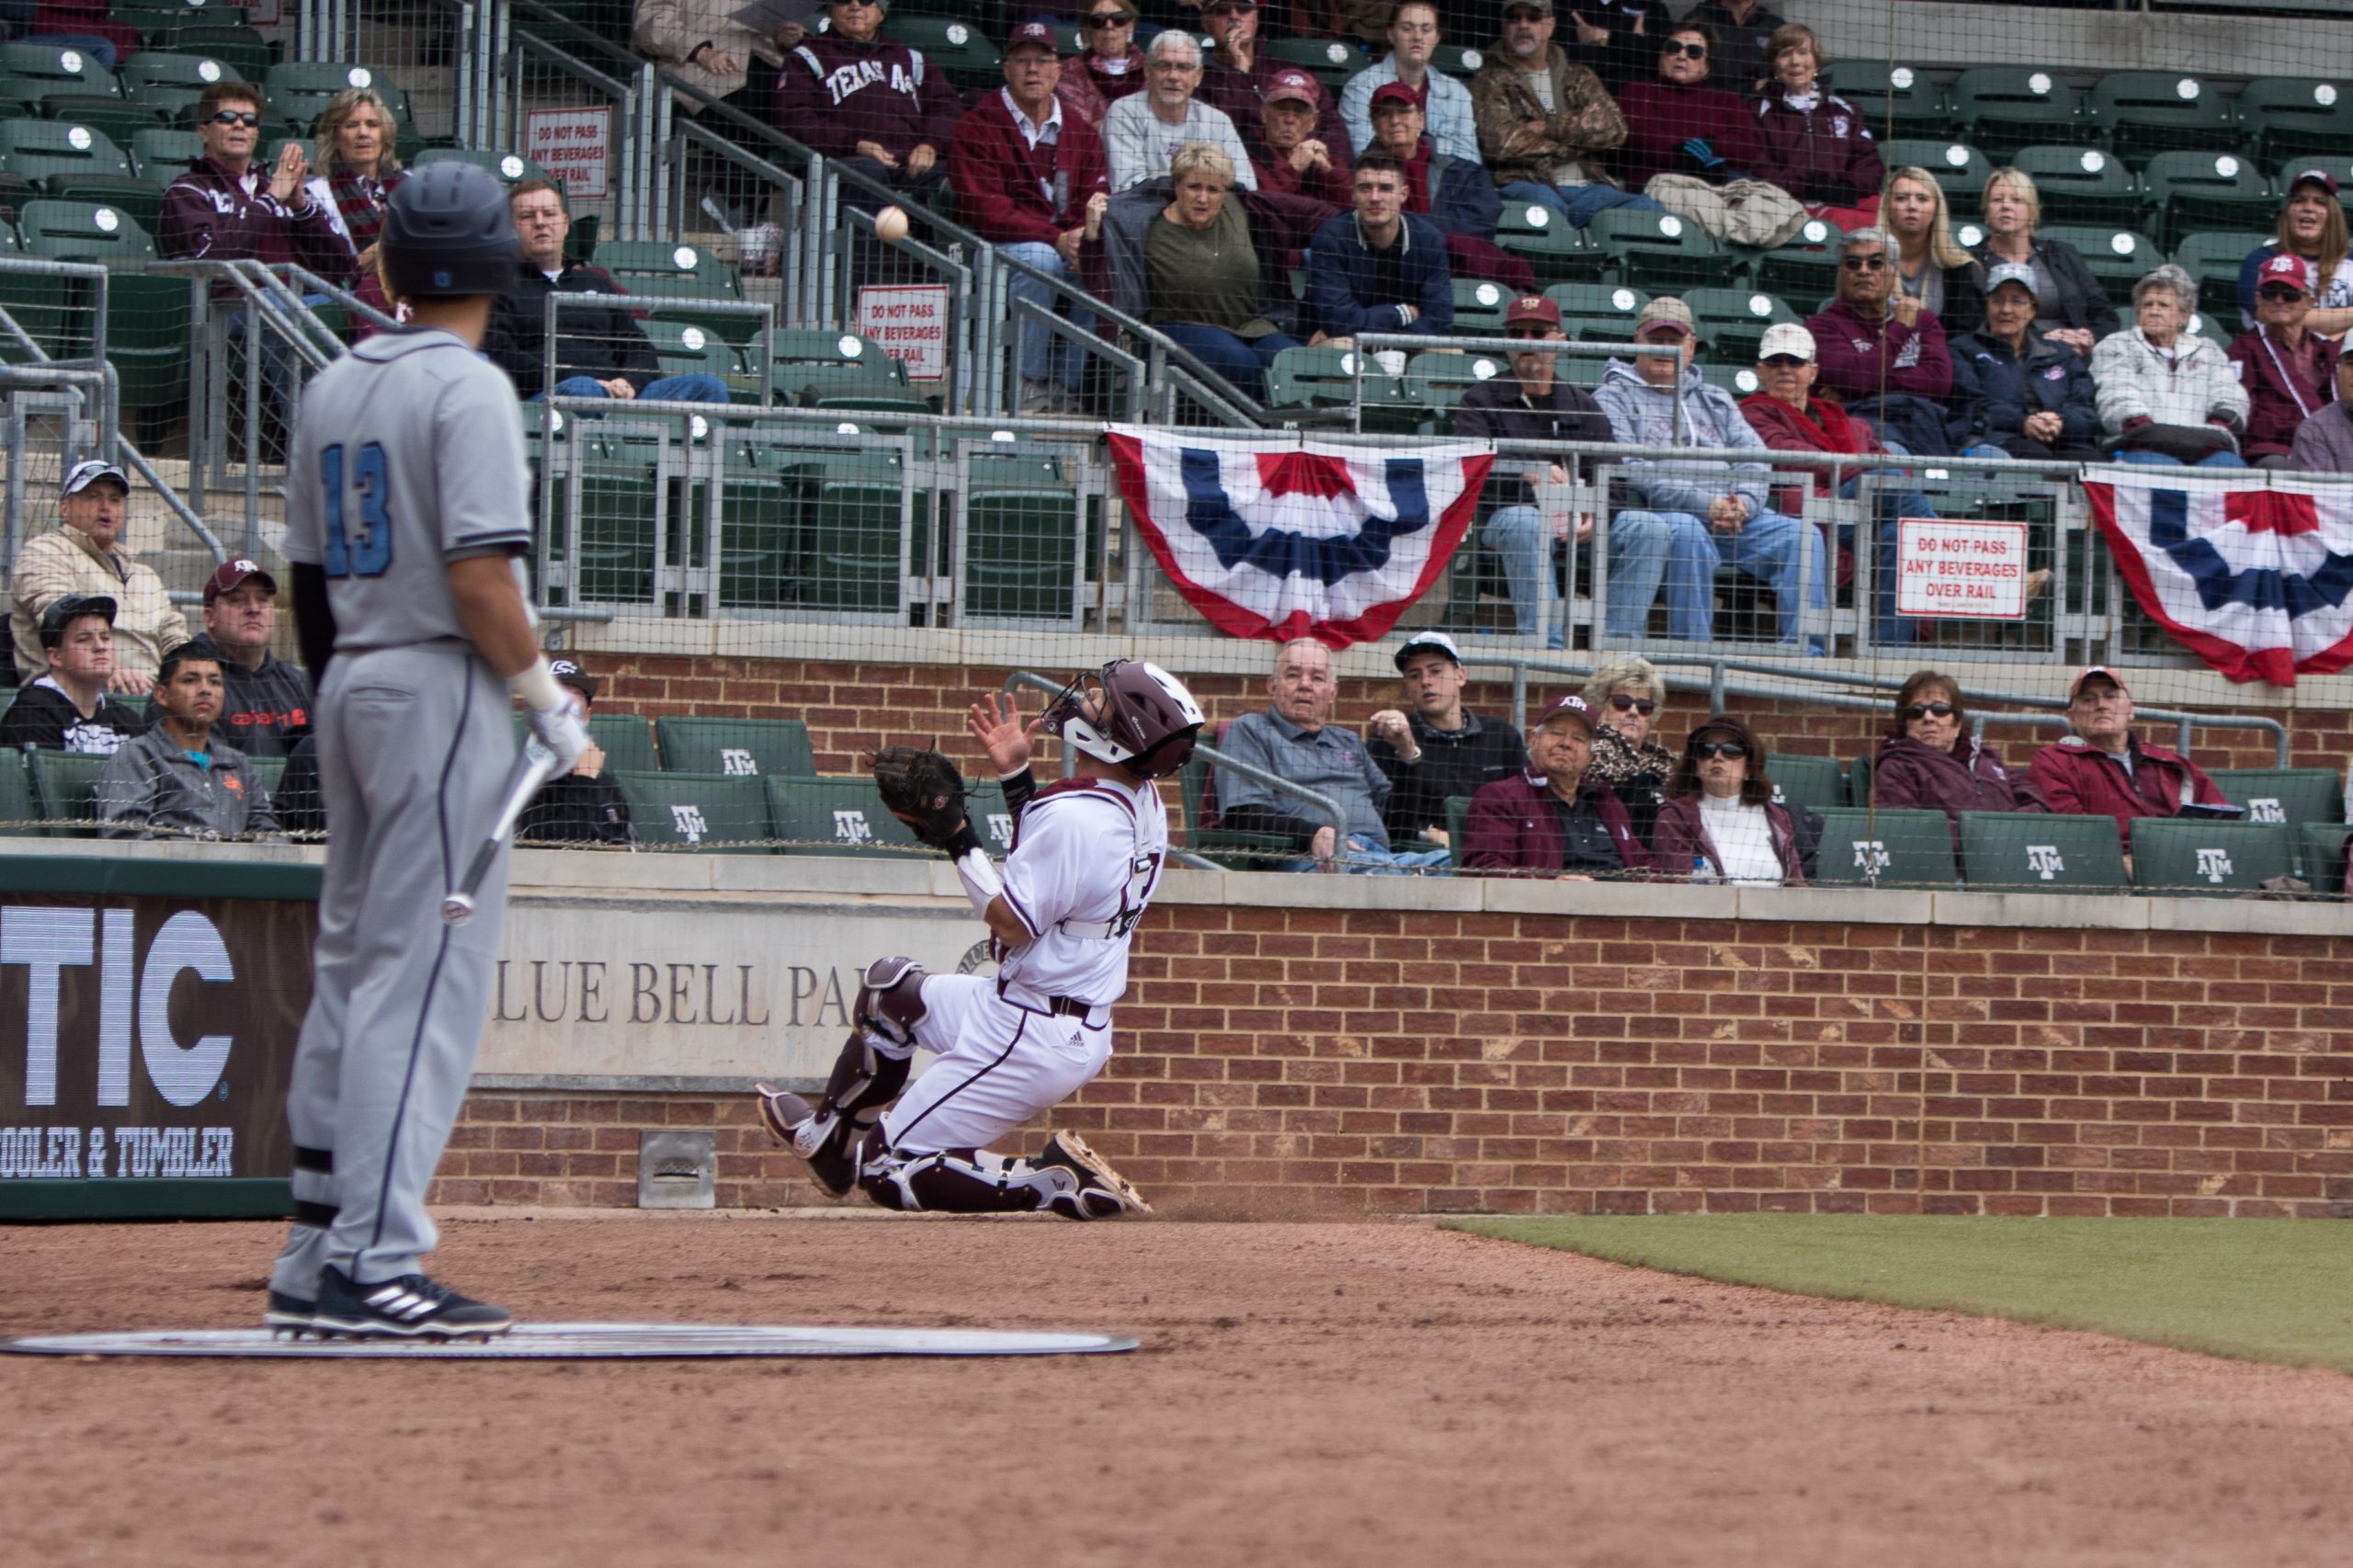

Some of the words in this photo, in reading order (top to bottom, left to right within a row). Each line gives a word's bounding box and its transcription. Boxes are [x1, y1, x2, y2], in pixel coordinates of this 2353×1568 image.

[539, 127, 551, 141] DO
[553, 126, 572, 140] NOT
[574, 124, 597, 139] PASS
[530, 148, 549, 163] ANY
[551, 145, 604, 161] BEVERAGES
[570, 168, 590, 182] RAIL
[871, 304, 884, 319] DO
[887, 304, 906, 319] NOT
[909, 303, 934, 318] PASS
[864, 326, 881, 341] ANY
[884, 325, 941, 341] BEVERAGES
[904, 347, 925, 362] RAIL
[321, 442, 393, 580] 13
[1918, 538, 1937, 551] DO
[1942, 539, 1969, 552] NOT
[1973, 540, 2006, 554] PASS
[1905, 560, 1933, 574] ANY
[1938, 561, 2018, 577] BEVERAGES
[1927, 583, 1961, 597] OVER
[1967, 585, 1996, 599] RAIL
[492, 960, 608, 1023] LUE
[627, 962, 769, 1026] BELL
[786, 966, 866, 1027] PA
[1, 906, 234, 1107] TIC
[87, 1127, 108, 1177] &
[115, 1127, 233, 1177] TUMBLER
